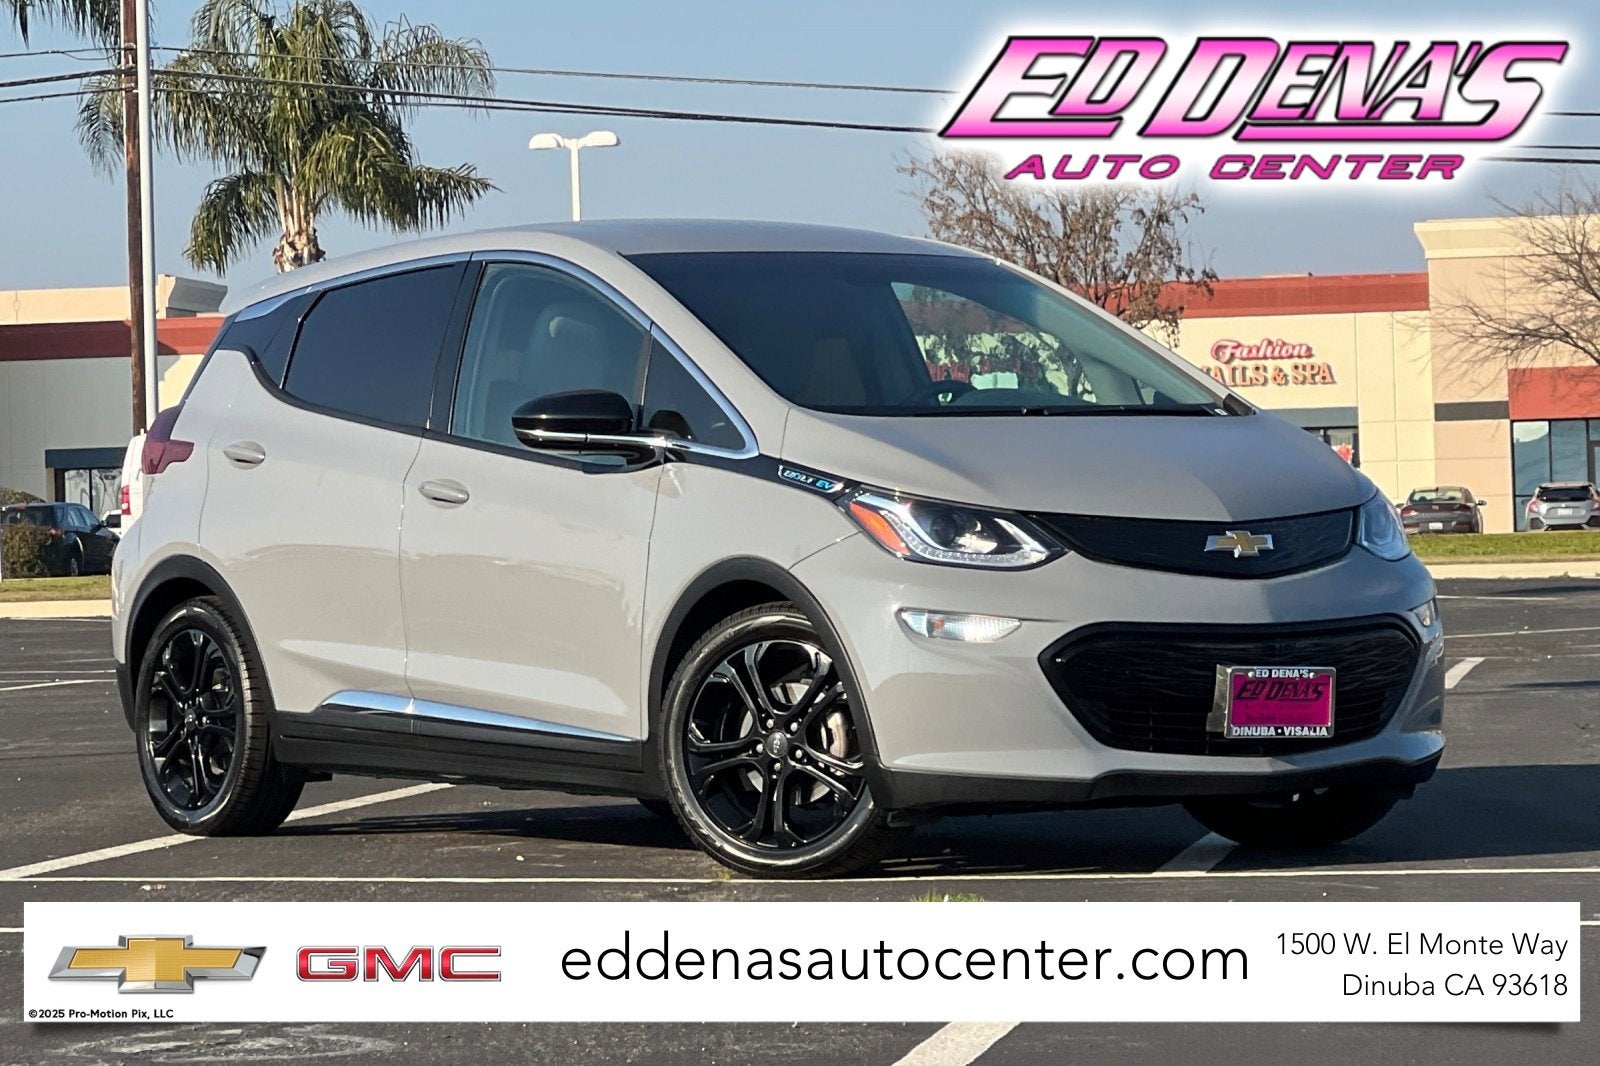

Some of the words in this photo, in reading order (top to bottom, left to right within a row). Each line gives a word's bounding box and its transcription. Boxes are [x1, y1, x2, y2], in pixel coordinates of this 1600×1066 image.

[1211, 338, 1313, 364] Fashion
[1271, 365, 1286, 385] &
[1291, 362, 1335, 385] SPA
[816, 479, 836, 489] EV
[1255, 669, 1269, 678] ED
[1271, 669, 1309, 678] DENA'S
[1236, 680, 1266, 700] ED
